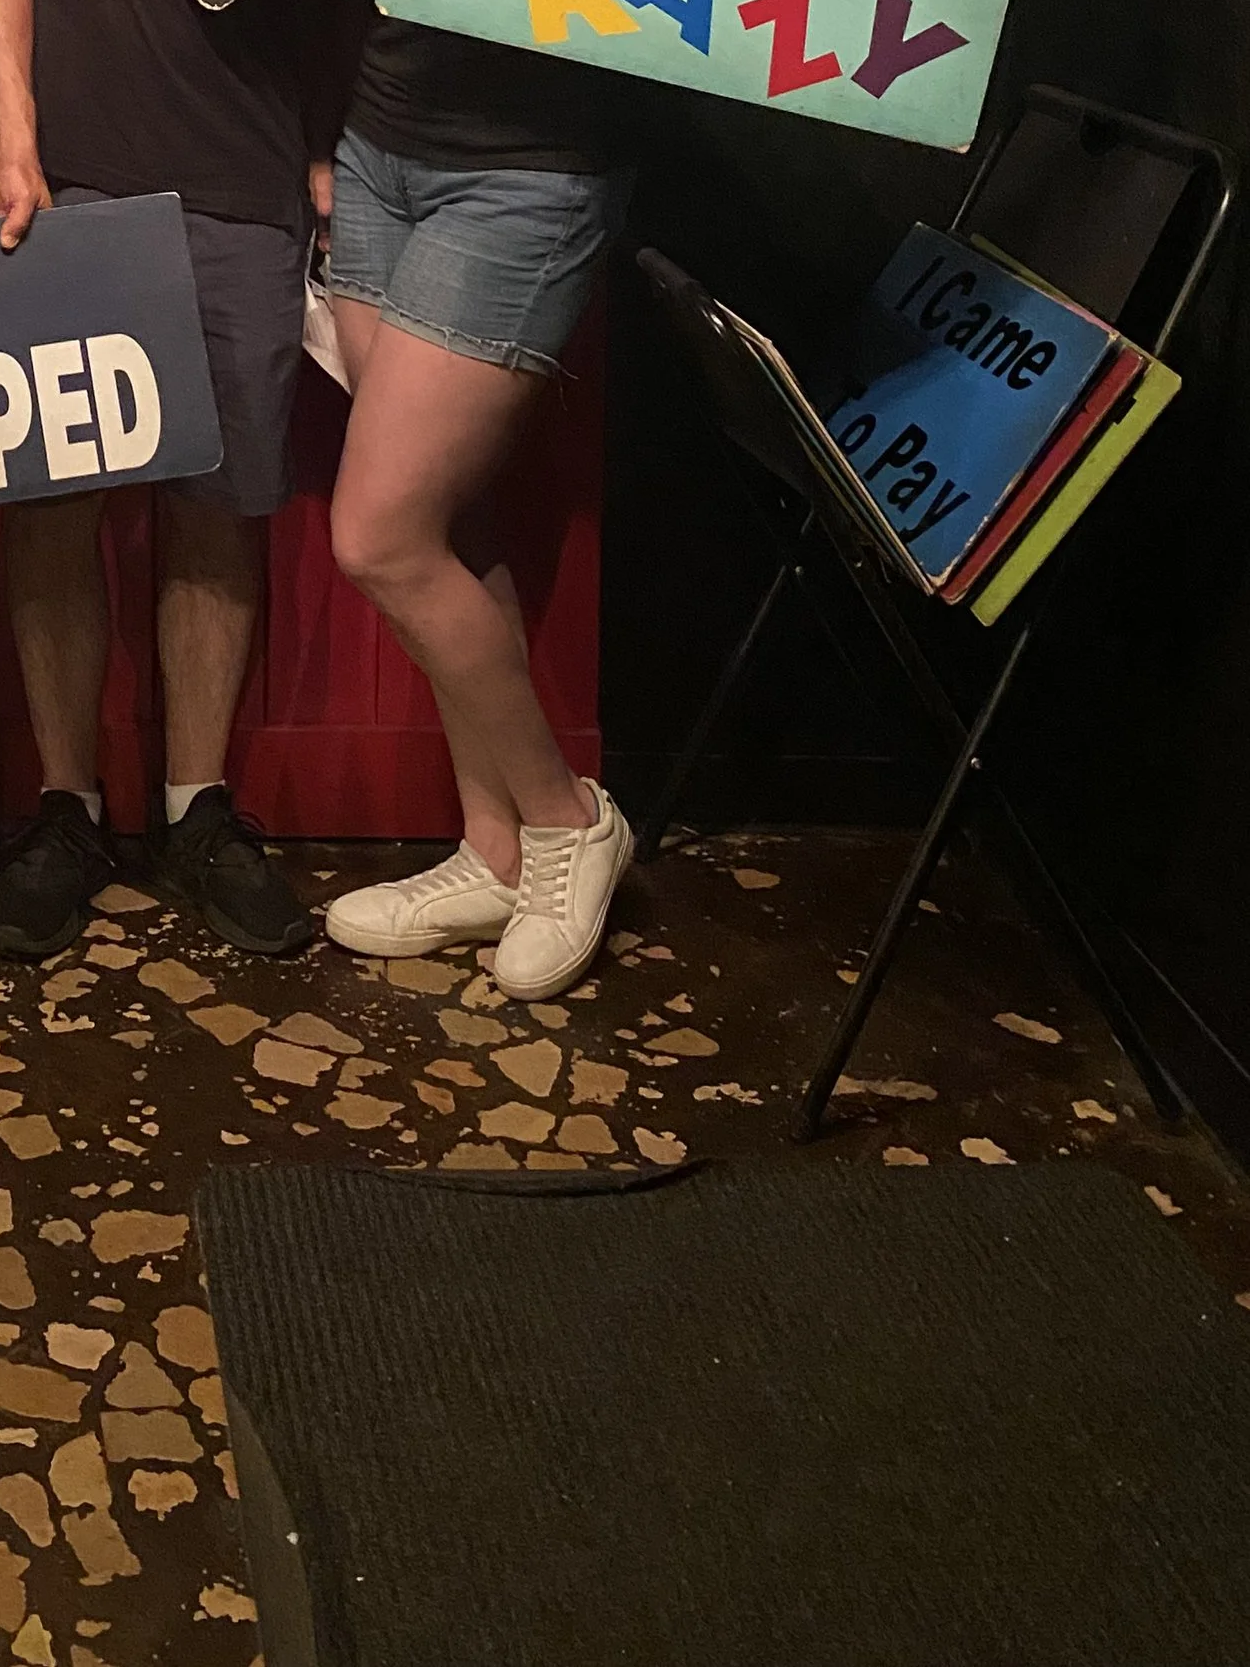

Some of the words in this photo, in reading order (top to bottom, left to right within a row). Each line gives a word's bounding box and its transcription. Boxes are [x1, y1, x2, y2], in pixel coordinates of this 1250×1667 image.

[895, 255, 946, 311] I
[919, 270, 1057, 390] Came
[863, 423, 971, 543] Pay
